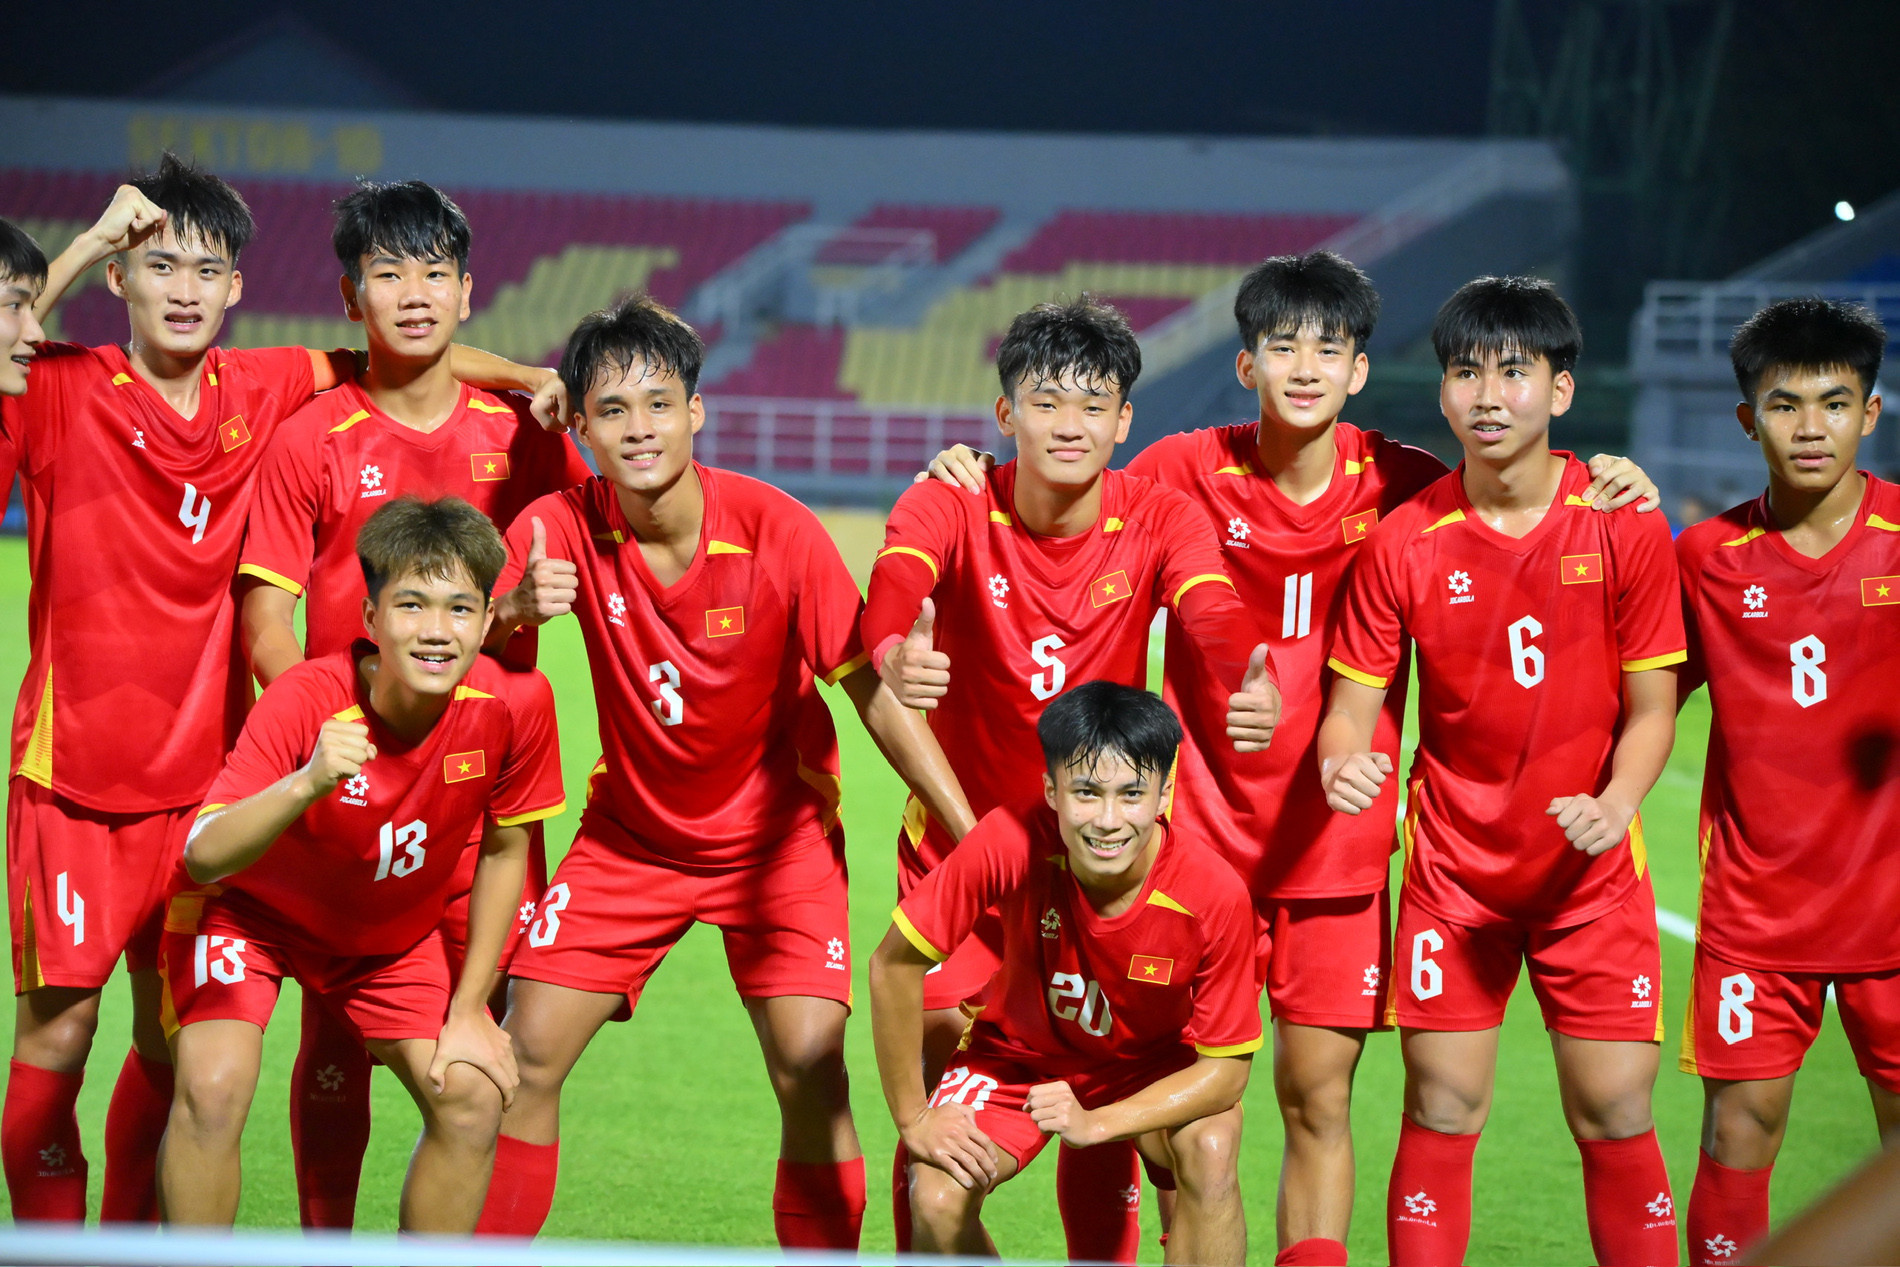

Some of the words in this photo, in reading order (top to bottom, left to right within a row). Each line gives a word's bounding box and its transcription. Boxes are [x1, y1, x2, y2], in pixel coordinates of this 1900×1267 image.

[178, 482, 212, 545] 4
[1281, 571, 1313, 640] 11
[1028, 633, 1067, 702] 5
[1507, 614, 1545, 690] 6
[1789, 633, 1828, 709] 8
[649, 660, 684, 726] 3
[374, 818, 428, 881] 13
[56, 870, 85, 947] 4
[528, 881, 572, 949] 3
[194, 934, 247, 990] 13
[1410, 928, 1444, 1002] 6
[1048, 971, 1113, 1037] 20
[1717, 972, 1756, 1046] 8
[927, 1066, 999, 1111] 20
